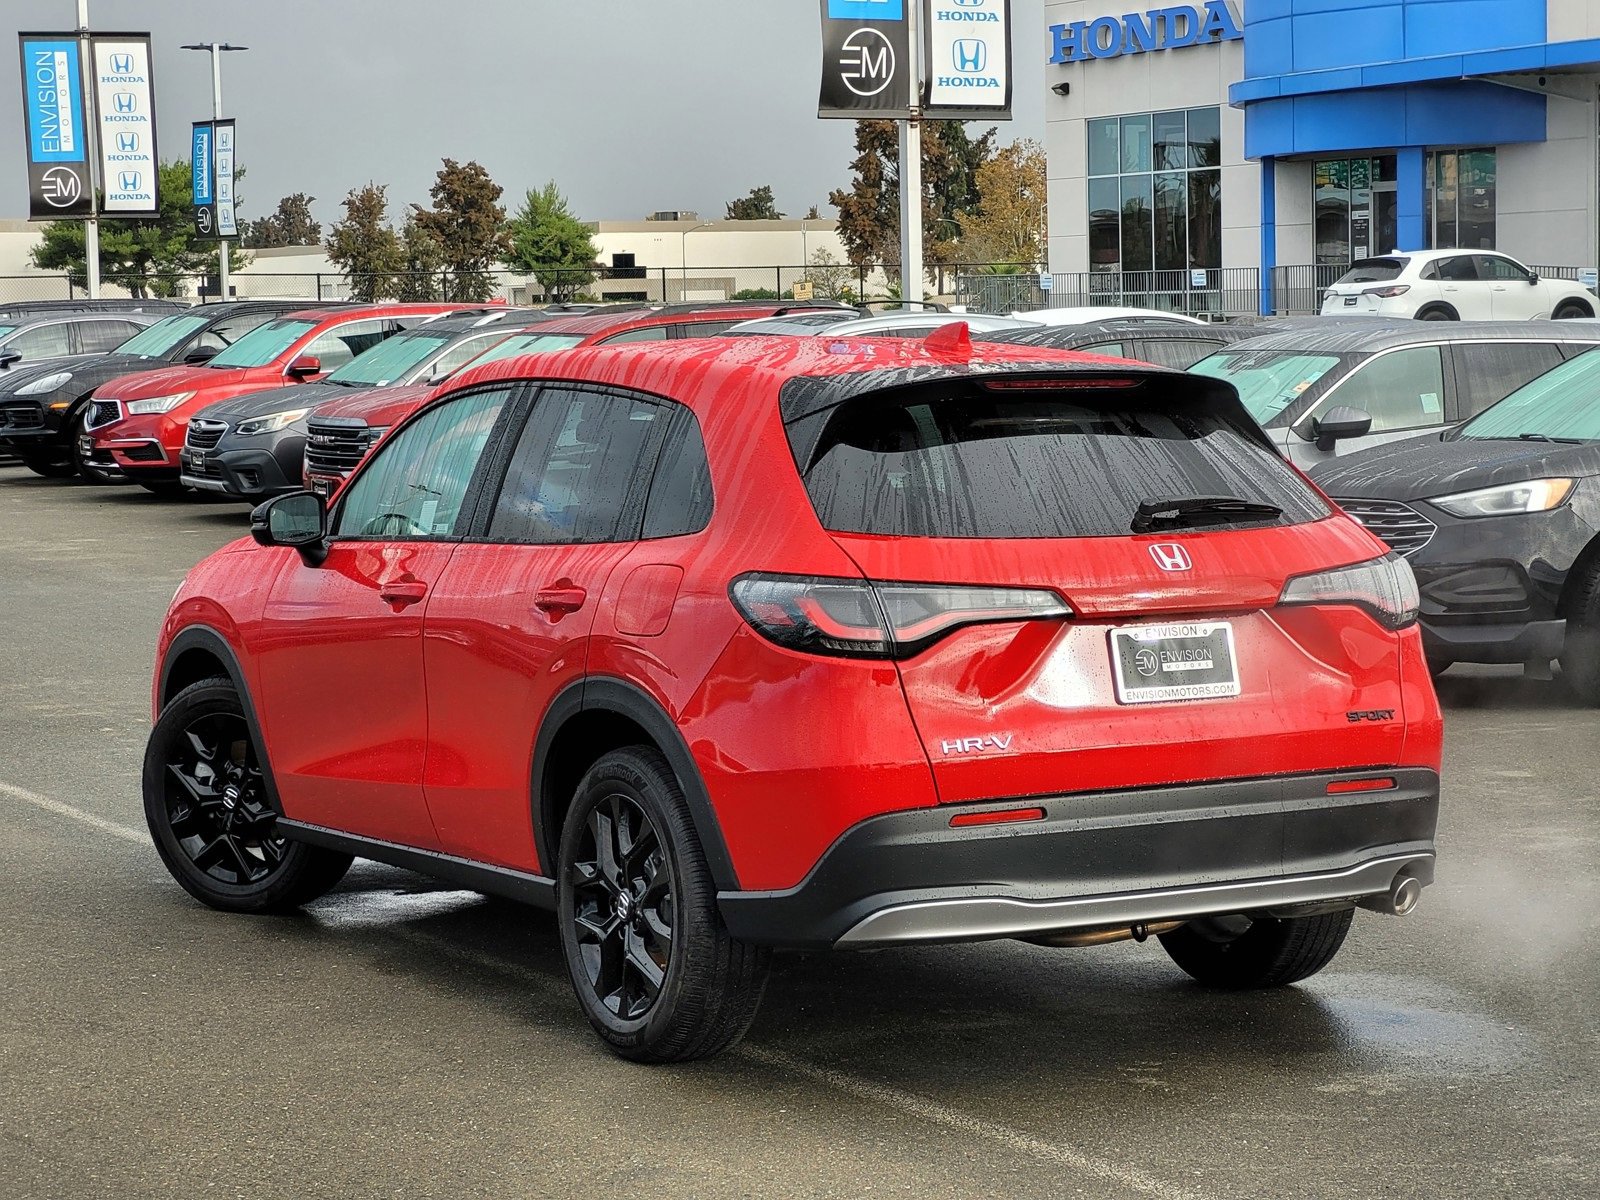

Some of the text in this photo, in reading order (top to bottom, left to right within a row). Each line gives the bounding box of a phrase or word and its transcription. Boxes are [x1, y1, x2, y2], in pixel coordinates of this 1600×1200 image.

[937, 11, 999, 22] HONDA
[1048, 0, 1244, 64] HONDA
[938, 77, 1000, 87] HONDA
[35, 51, 60, 153] ENVISION
[58, 60, 70, 143] MOTORS
[196, 133, 204, 199] ENVISION
[1160, 649, 1212, 663] ENVISION
[1126, 684, 1235, 701] ENVISIONMOTORS.COM
[1346, 709, 1395, 722] SPORT
[942, 735, 1012, 754] HR-V
